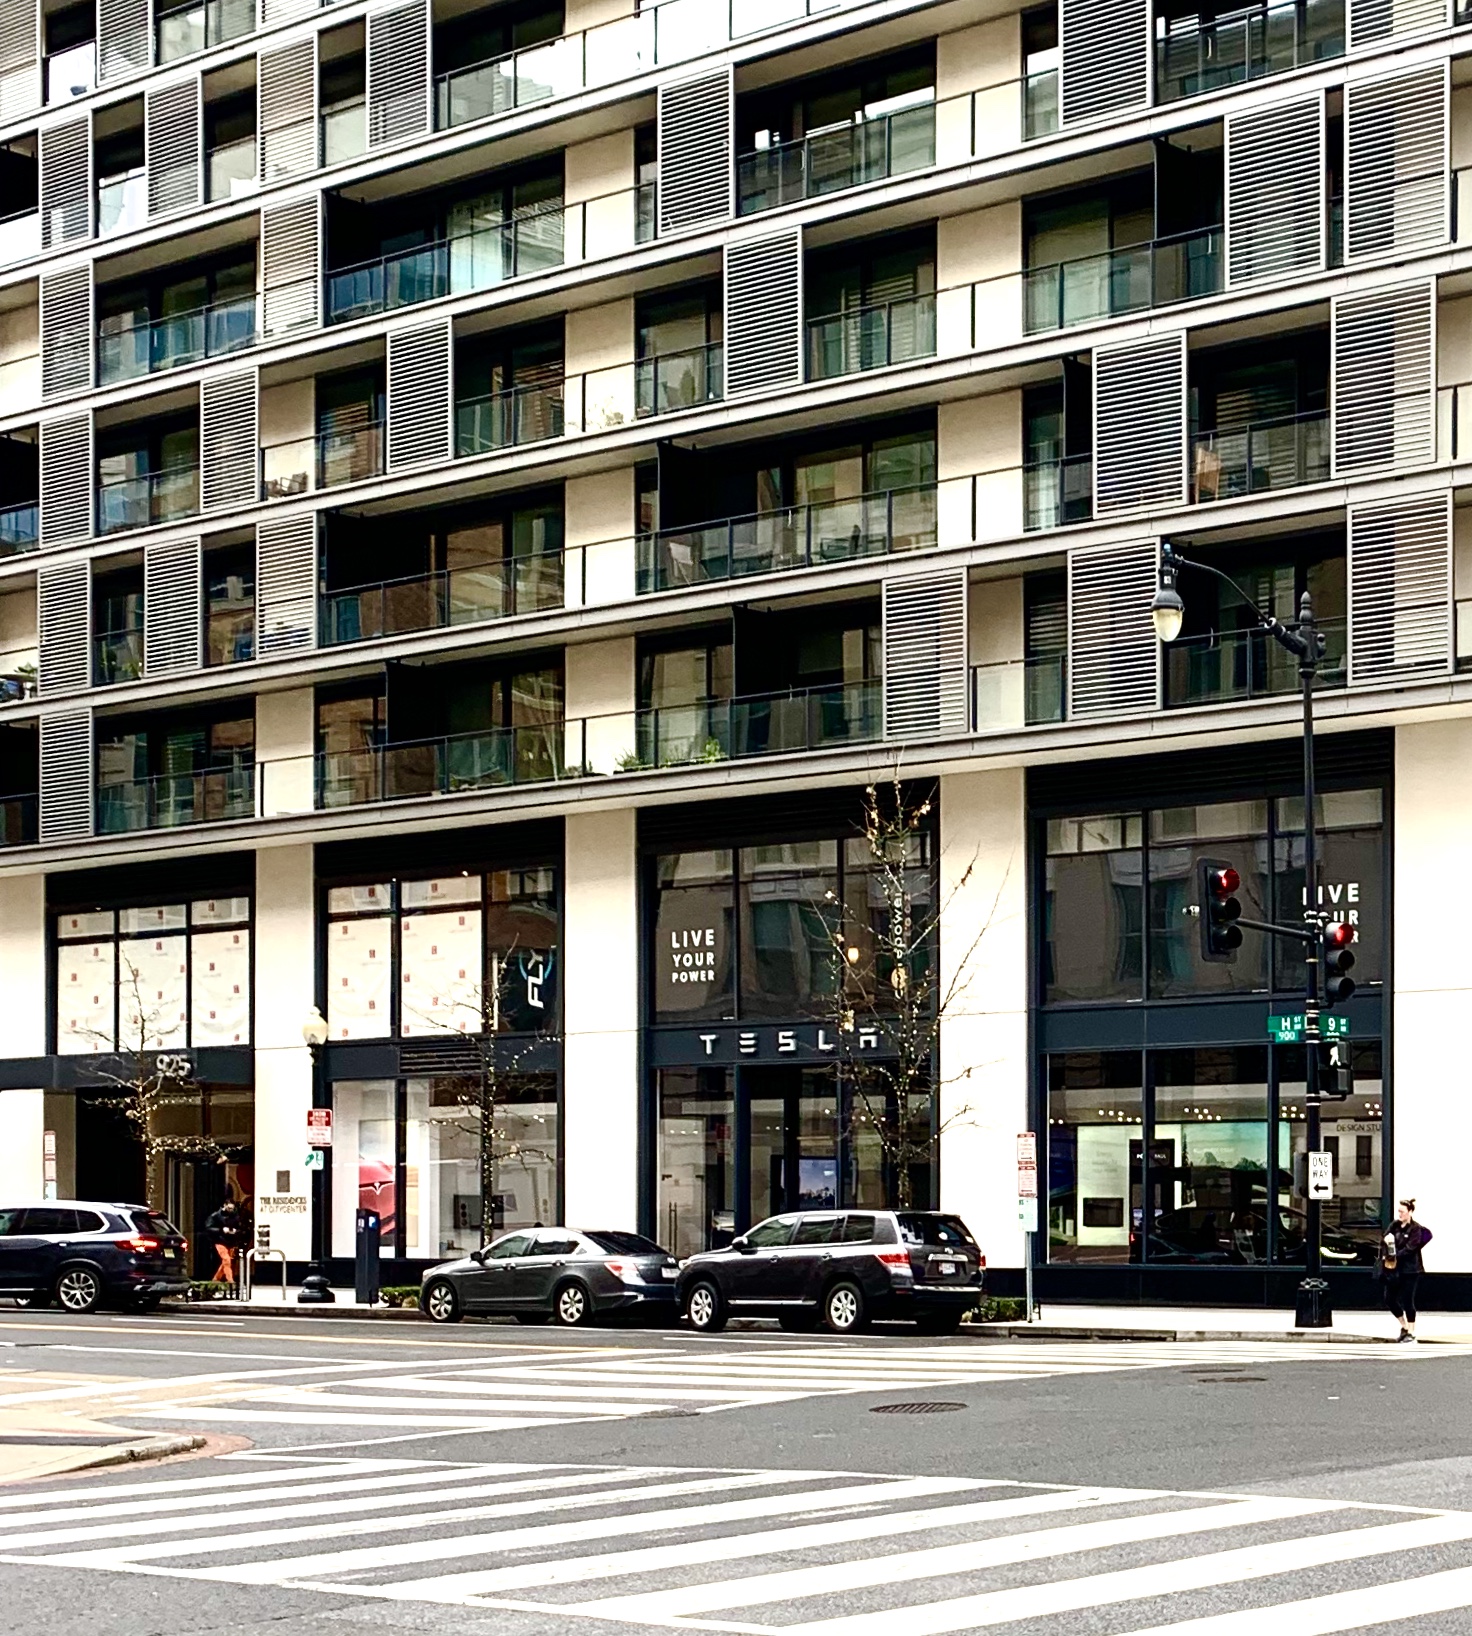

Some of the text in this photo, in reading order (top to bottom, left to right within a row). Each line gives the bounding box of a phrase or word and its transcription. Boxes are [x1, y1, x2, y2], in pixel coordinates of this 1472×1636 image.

[671, 928, 715, 949] LIVE
[672, 951, 715, 968] YOUR
[671, 969, 715, 983] POWER
[1281, 1016, 1291, 1031] H
[1328, 1017, 1336, 1031] 9
[699, 1026, 878, 1055] TESLA
[156, 1053, 191, 1077] 925
[1365, 1123, 1381, 1131] STU
[1312, 1157, 1329, 1168] ONE
